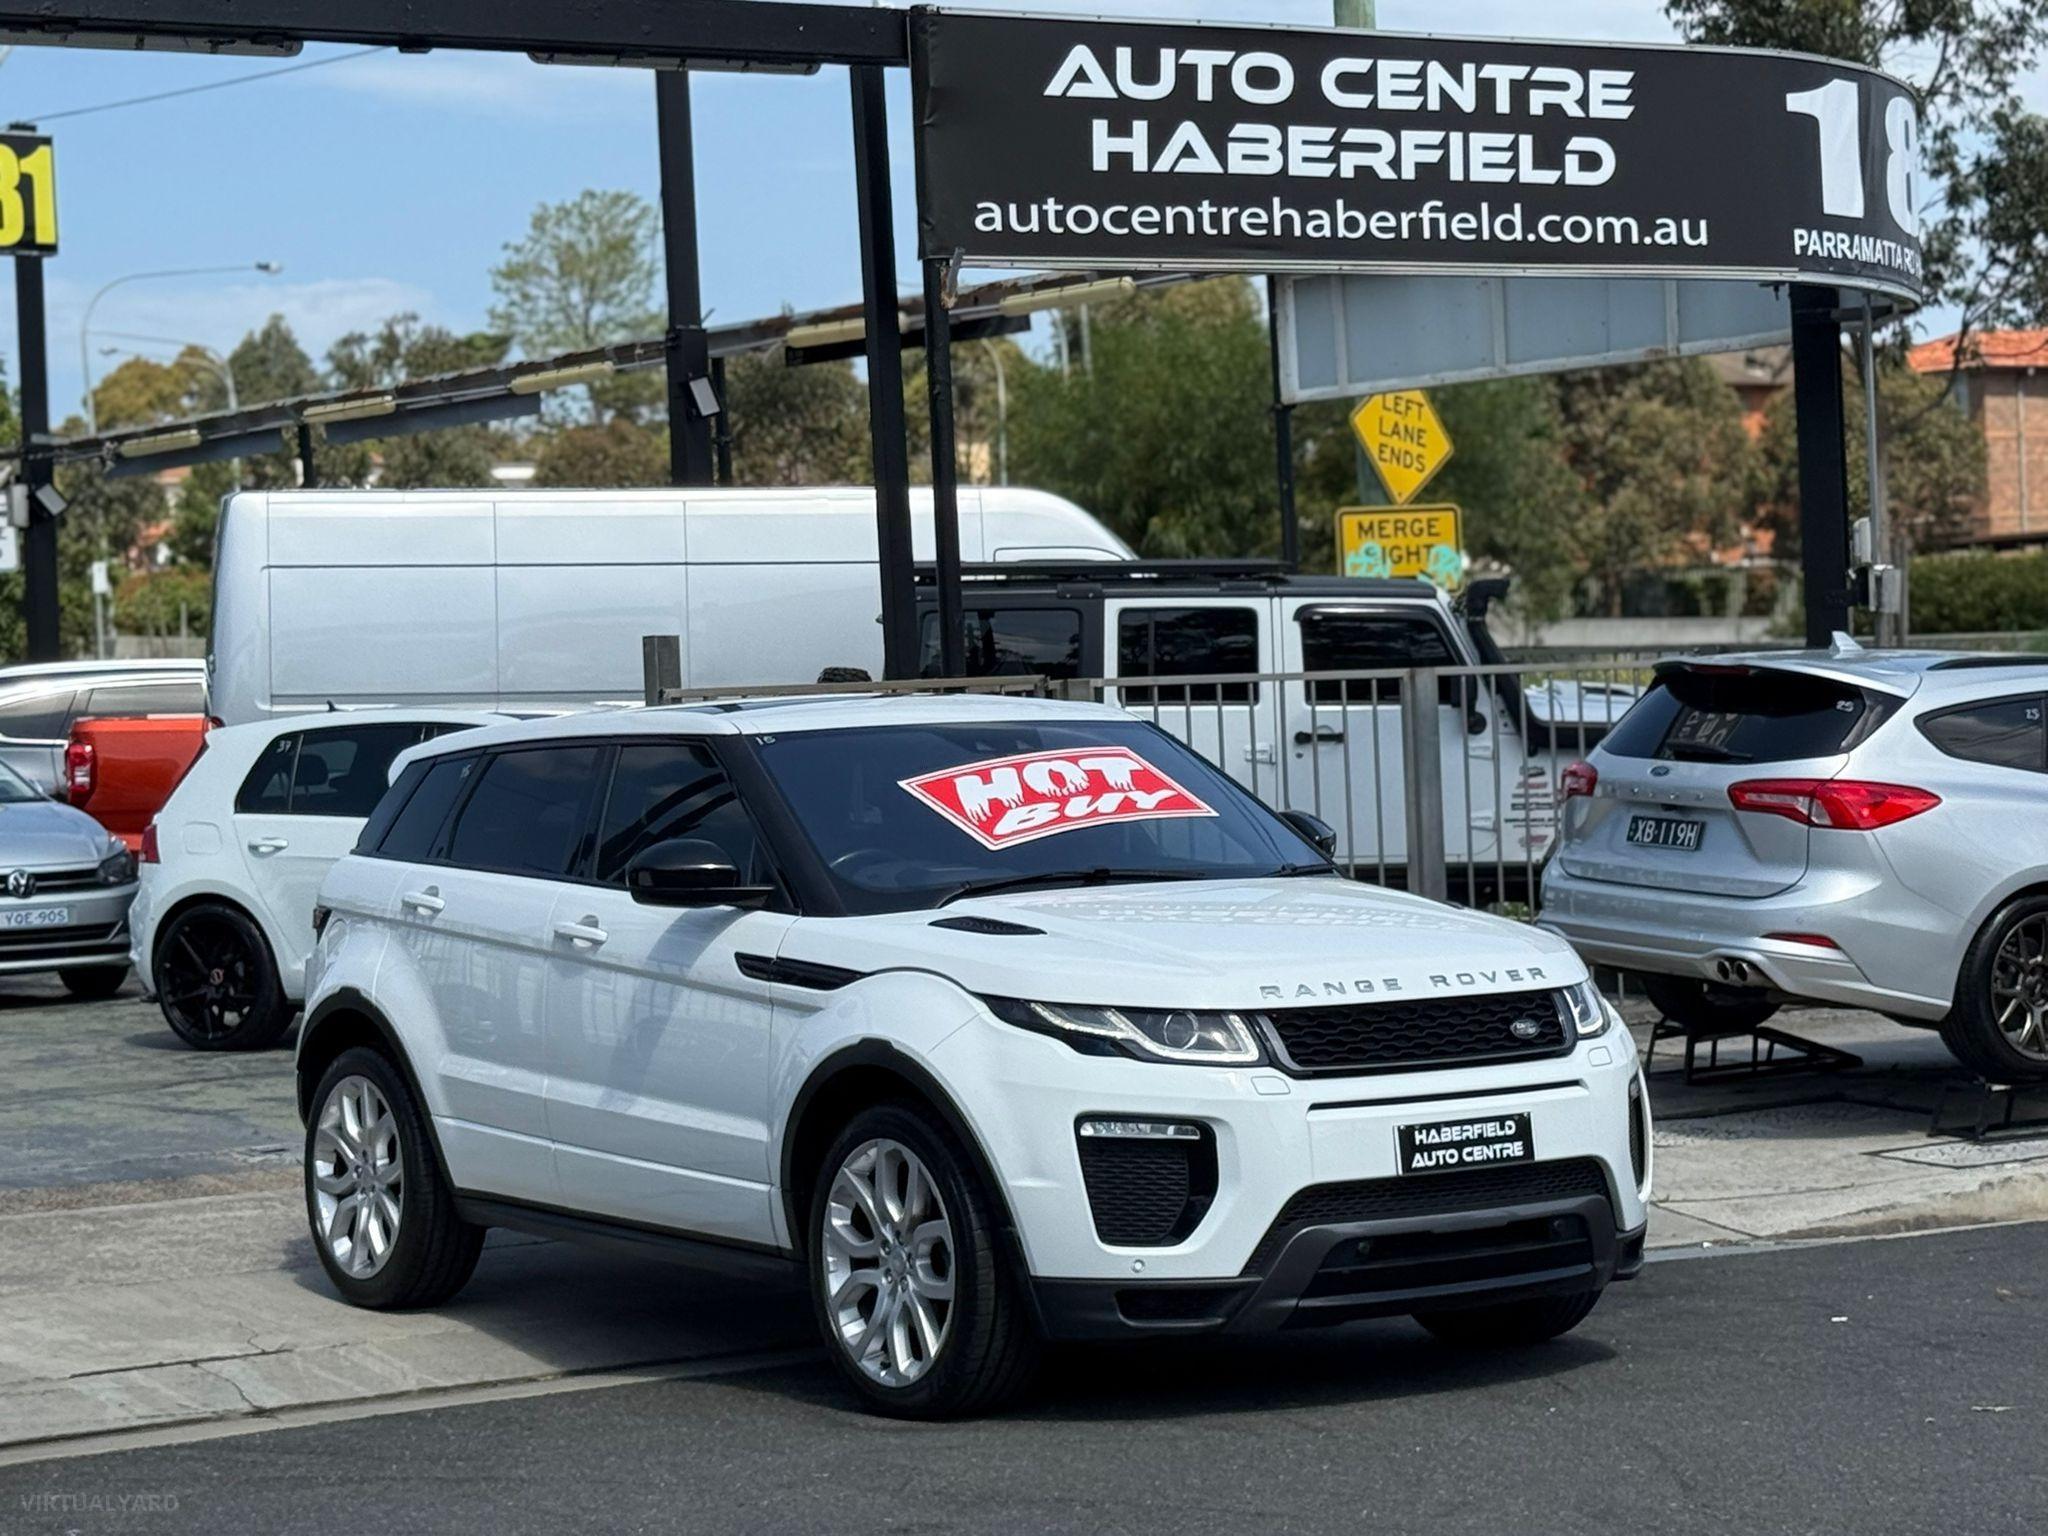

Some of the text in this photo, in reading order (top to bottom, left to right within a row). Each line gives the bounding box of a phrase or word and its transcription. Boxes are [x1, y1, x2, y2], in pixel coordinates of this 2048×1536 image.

[1043, 44, 1636, 121] AUTO CENTRE
[1091, 119, 1617, 187] HABERFIELD
[974, 197, 1709, 248] autocentrehaberfield.com.au
[1793, 228, 1903, 271] PARRAMATTA
[1382, 393, 1425, 421] LEFT
[1379, 417, 1428, 448] LANE
[1378, 443, 1426, 474] ENDS
[1357, 517, 1441, 540] MERGE
[1363, 544, 1436, 566] IGHT
[953, 757, 1144, 824] HOT
[992, 789, 1179, 836] BUY
[1258, 967, 1547, 1000] RANGE ROVER
[1414, 1119, 1516, 1146] HABERFIELD
[1411, 1141, 1524, 1169] AUTO CENTRE
